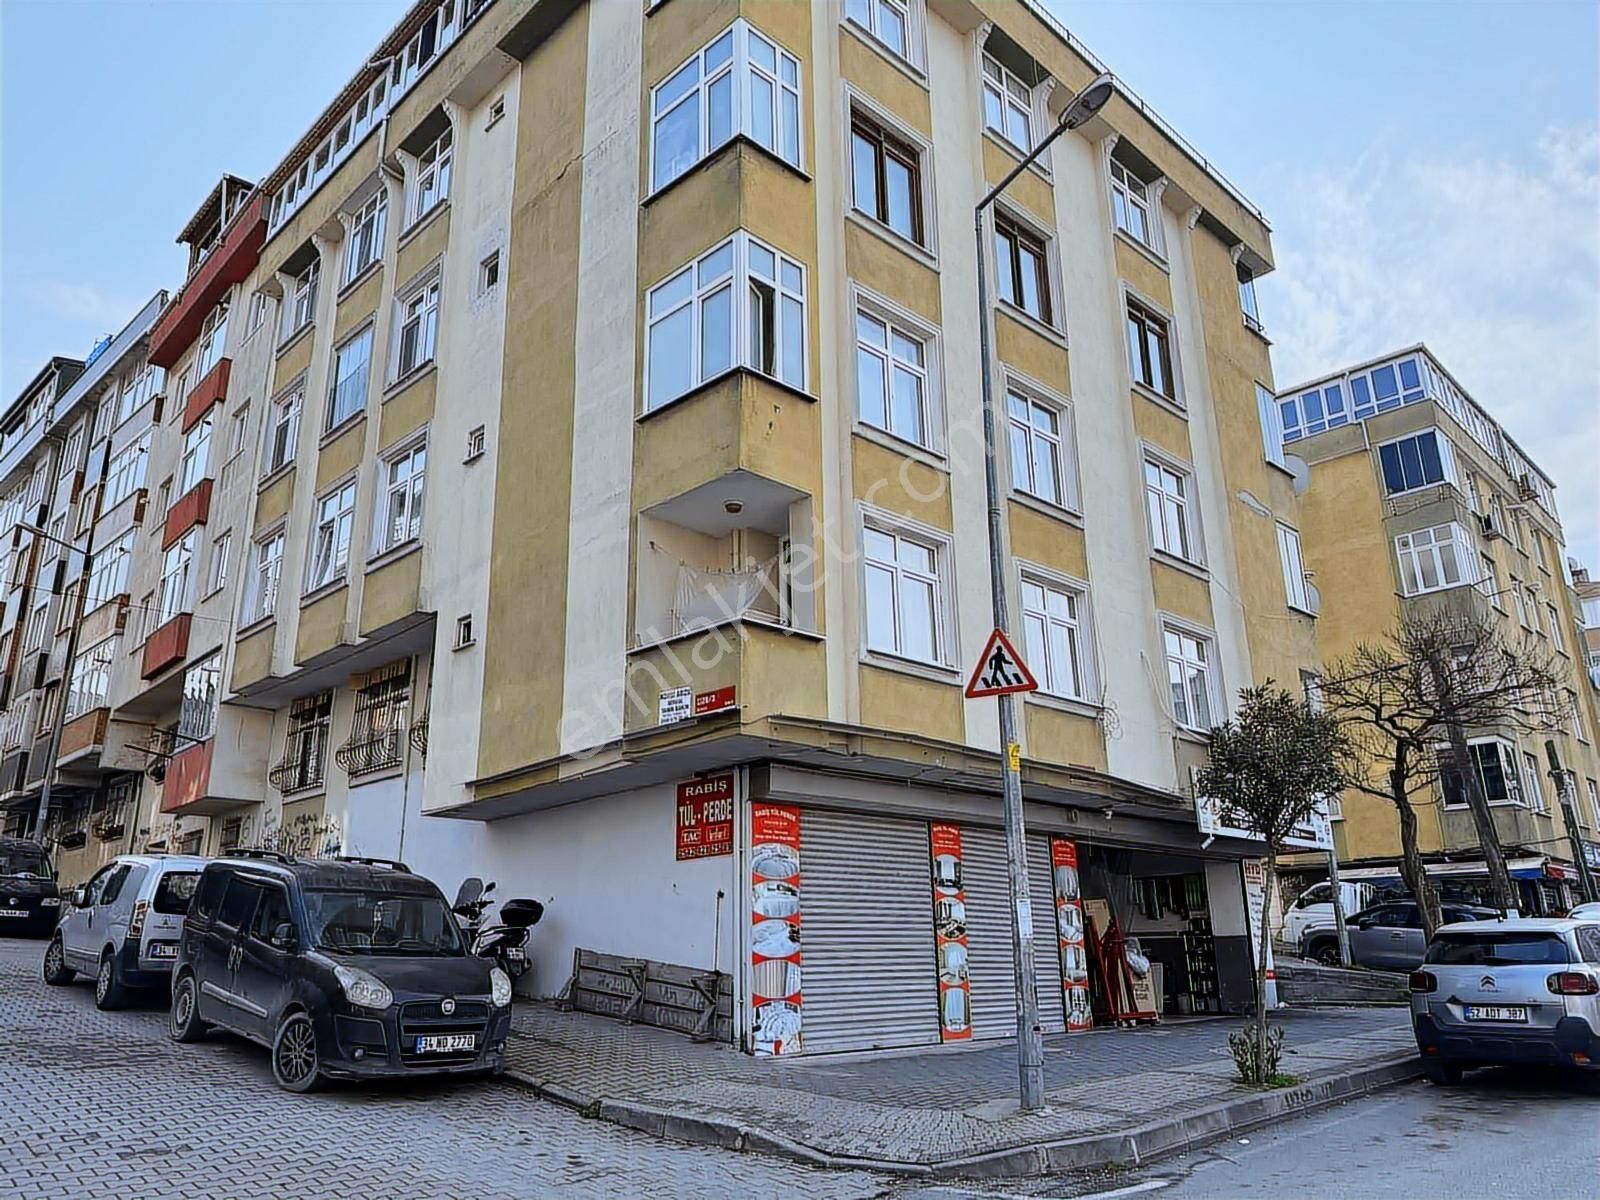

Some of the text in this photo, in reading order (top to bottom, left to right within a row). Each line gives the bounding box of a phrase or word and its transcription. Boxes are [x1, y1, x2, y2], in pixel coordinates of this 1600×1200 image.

[685, 780, 728, 797] RABİŞ
[703, 798, 732, 823] PERDE
[451, 1035, 473, 1047] 2770
